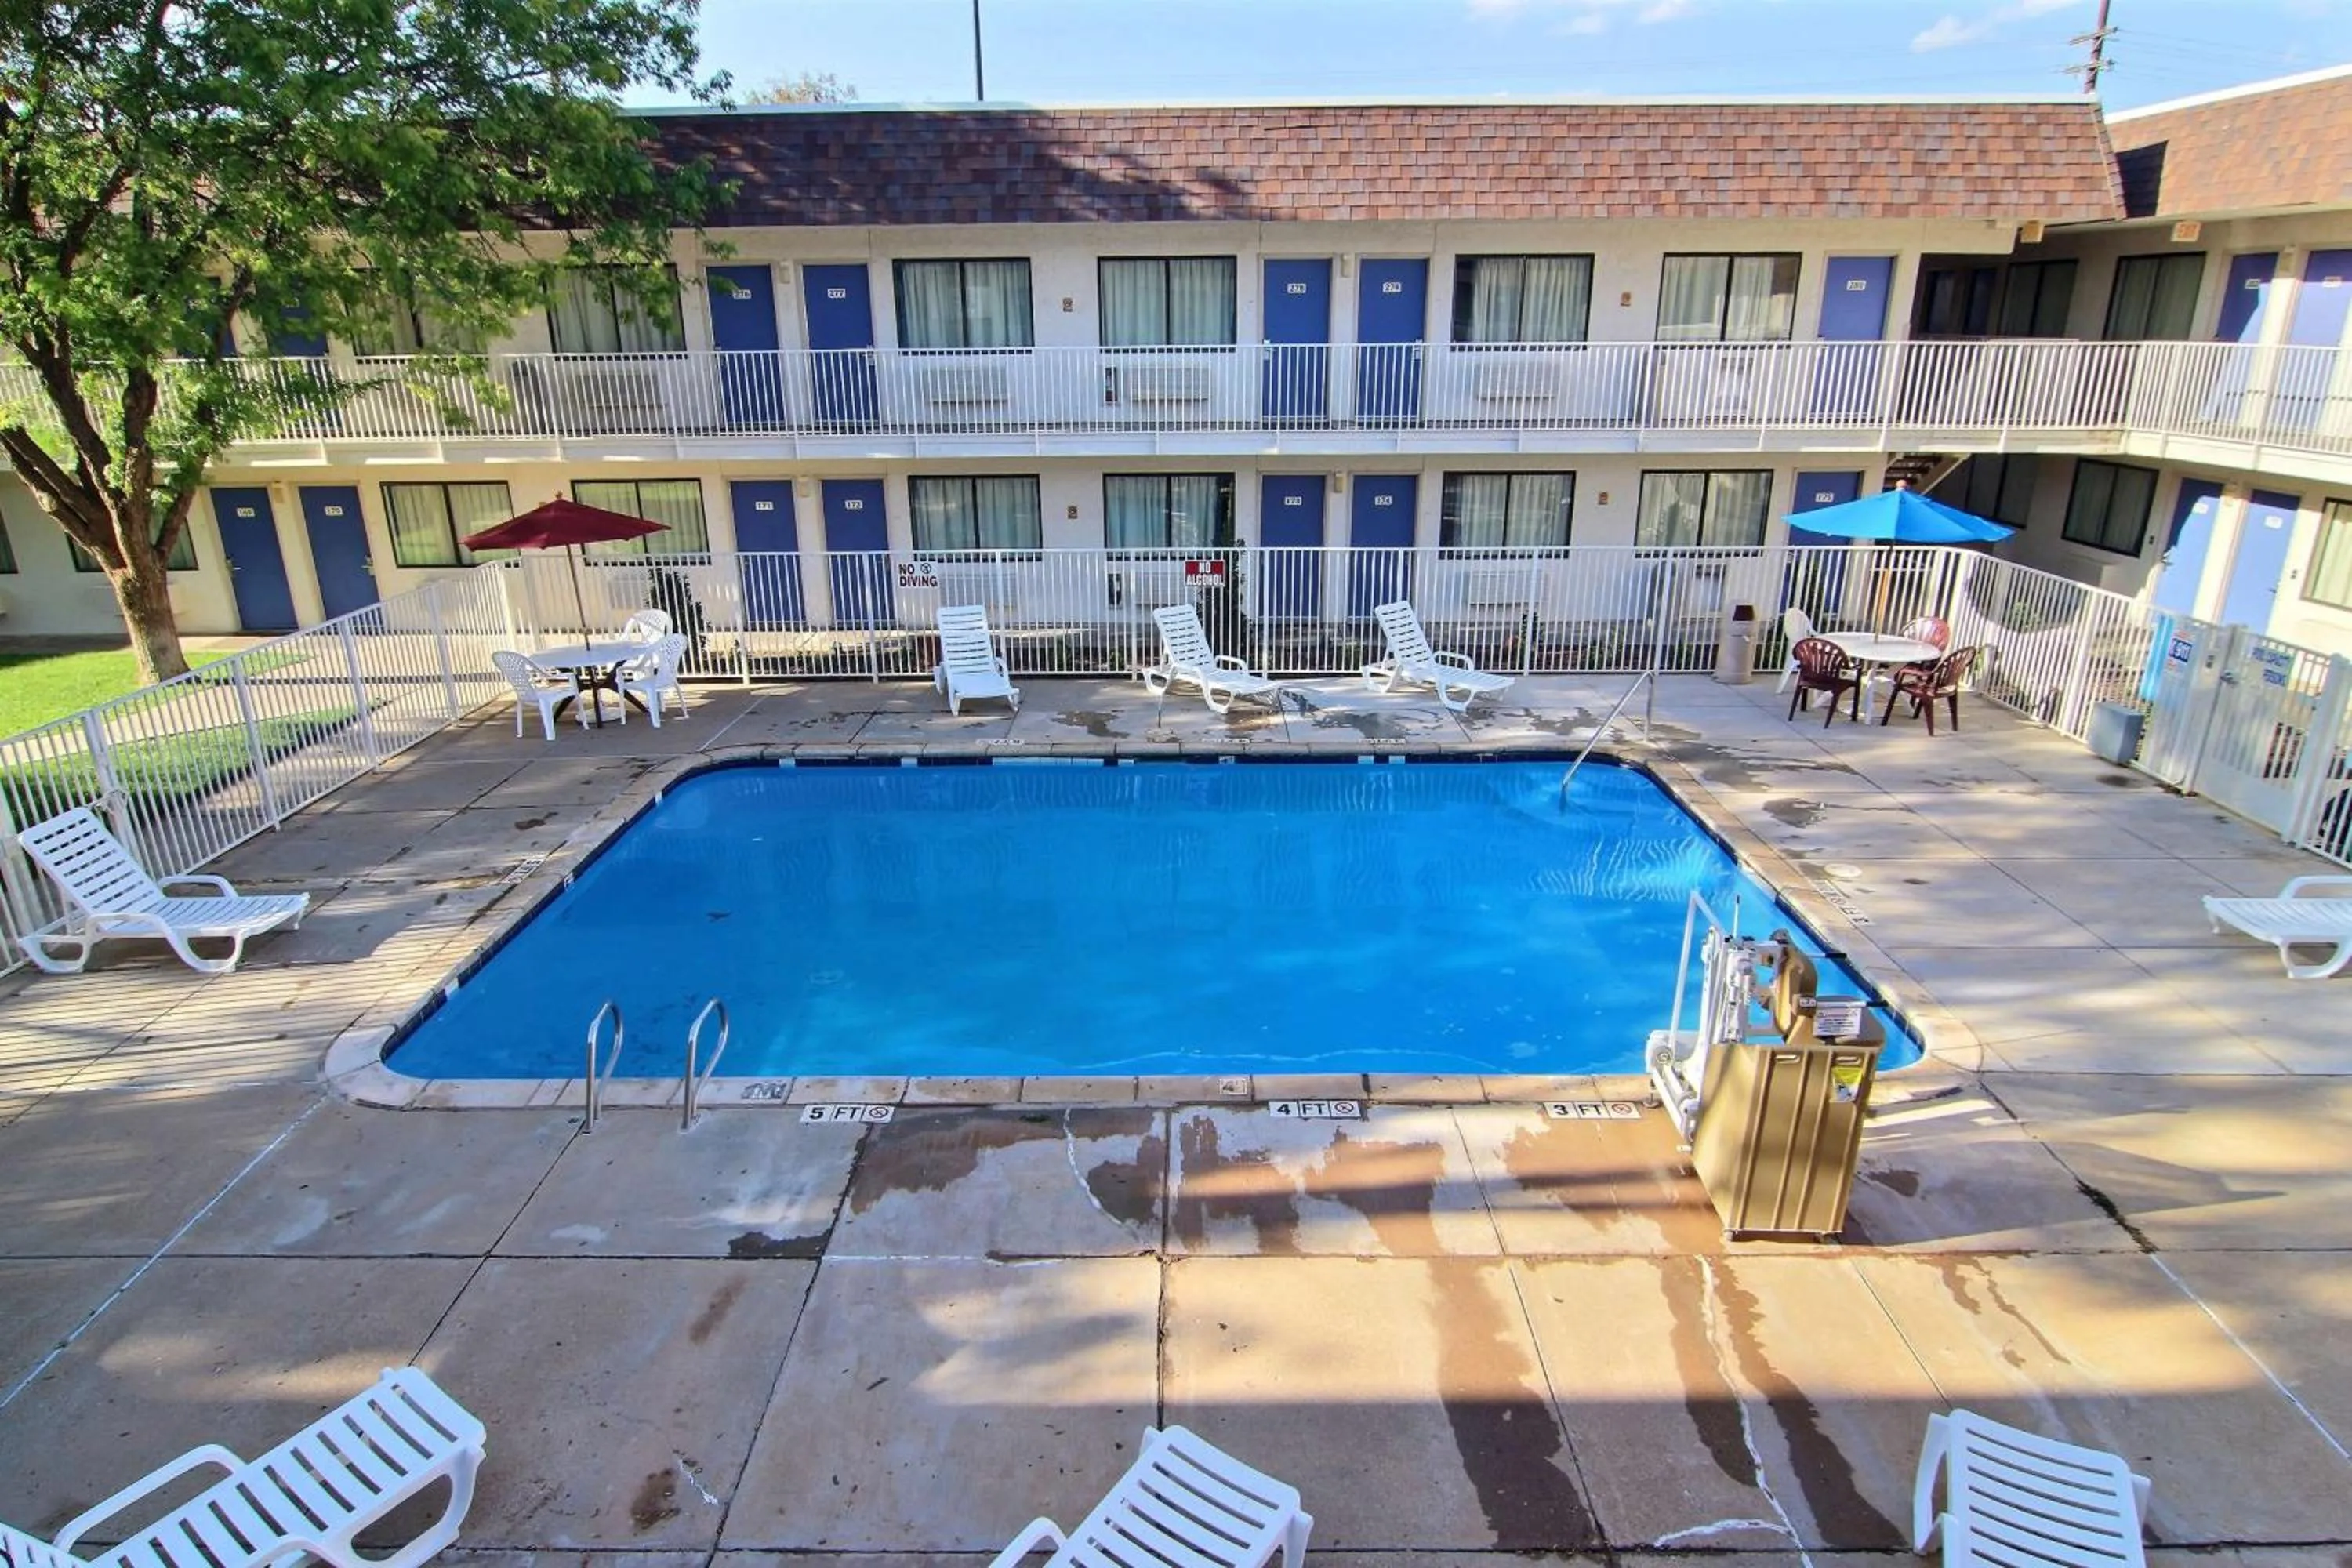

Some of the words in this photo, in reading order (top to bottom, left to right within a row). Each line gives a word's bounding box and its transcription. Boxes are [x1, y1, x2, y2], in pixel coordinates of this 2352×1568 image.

[898, 564, 915, 575] NO
[1199, 562, 1211, 573] NO
[899, 575, 938, 587] DIVING
[1186, 574, 1225, 586] ALCOHOL
[808, 1106, 826, 1120] 5
[834, 1106, 862, 1120] FT
[1277, 1103, 1291, 1115] 4
[1302, 1103, 1326, 1115] FT
[1552, 1104, 1569, 1116] 3
[1578, 1104, 1602, 1116] FT
